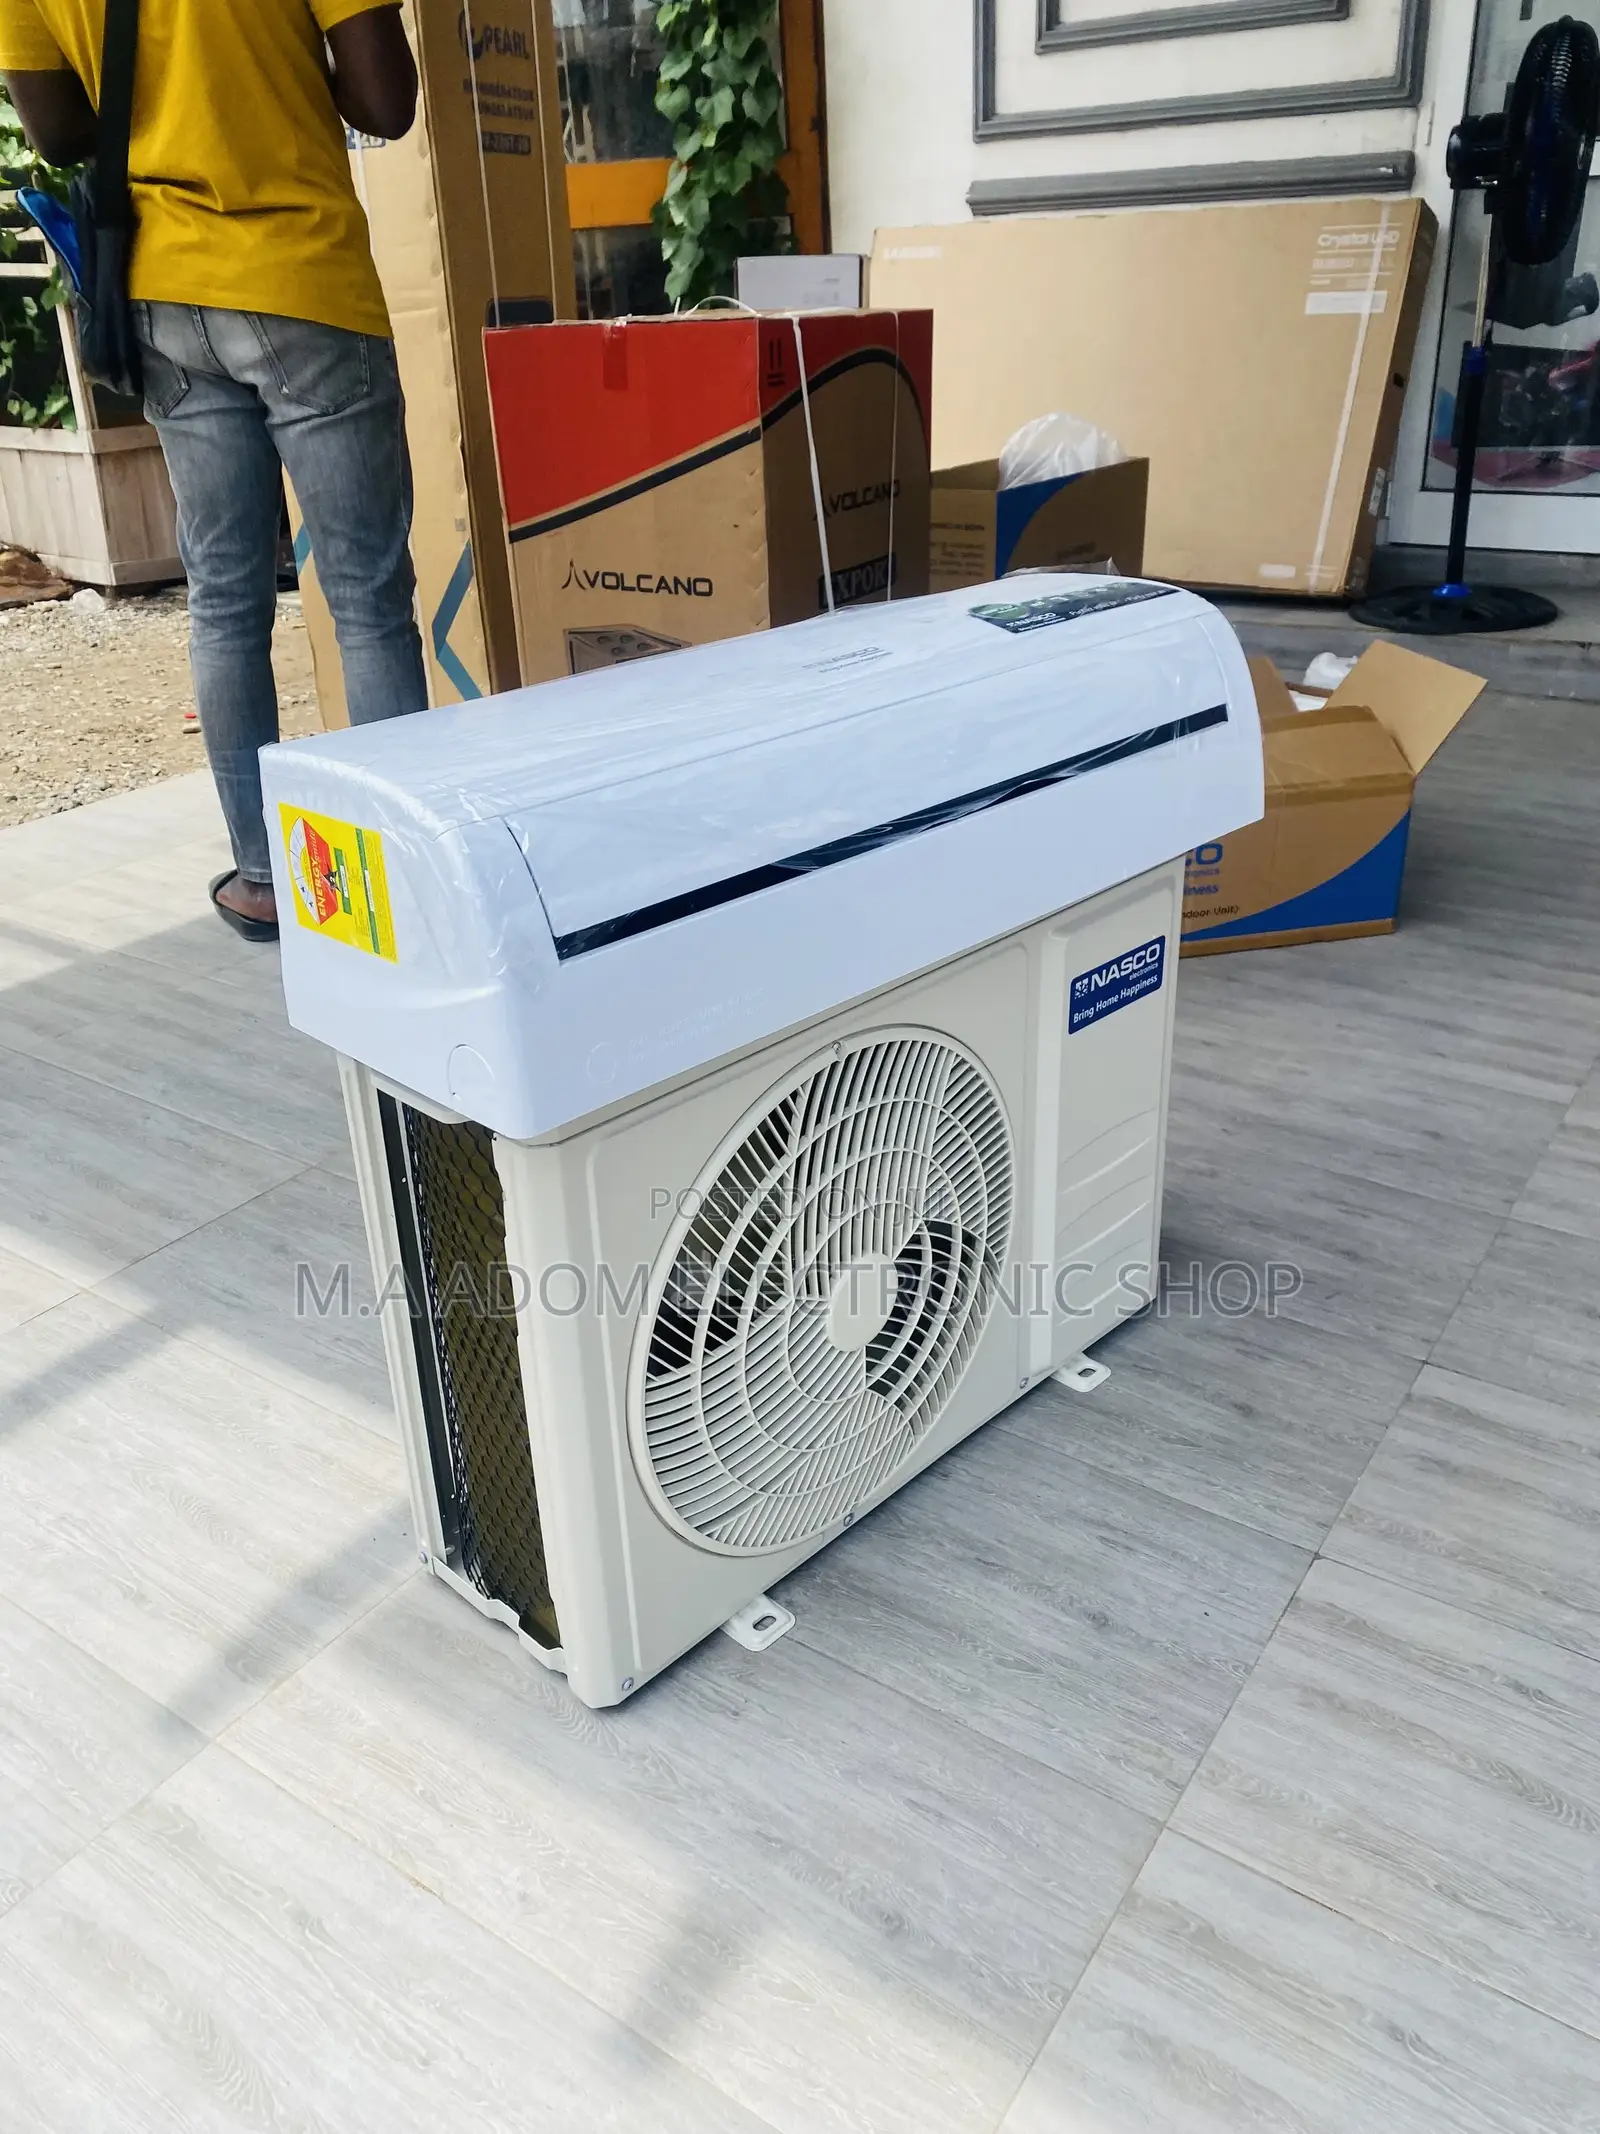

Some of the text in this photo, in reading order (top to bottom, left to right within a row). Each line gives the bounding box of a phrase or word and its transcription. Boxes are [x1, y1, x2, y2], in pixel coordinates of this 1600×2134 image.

[482, 24, 531, 60] PEARL
[828, 480, 900, 515] VOLCANO
[582, 568, 713, 597] VOLCANO
[822, 556, 895, 607] XPOR
[308, 829, 327, 918] ENERGY guide
[1090, 943, 1161, 992] NASCO
[1129, 961, 1158, 981] electronics
[1073, 974, 1158, 1024] Bring Home Happiness
